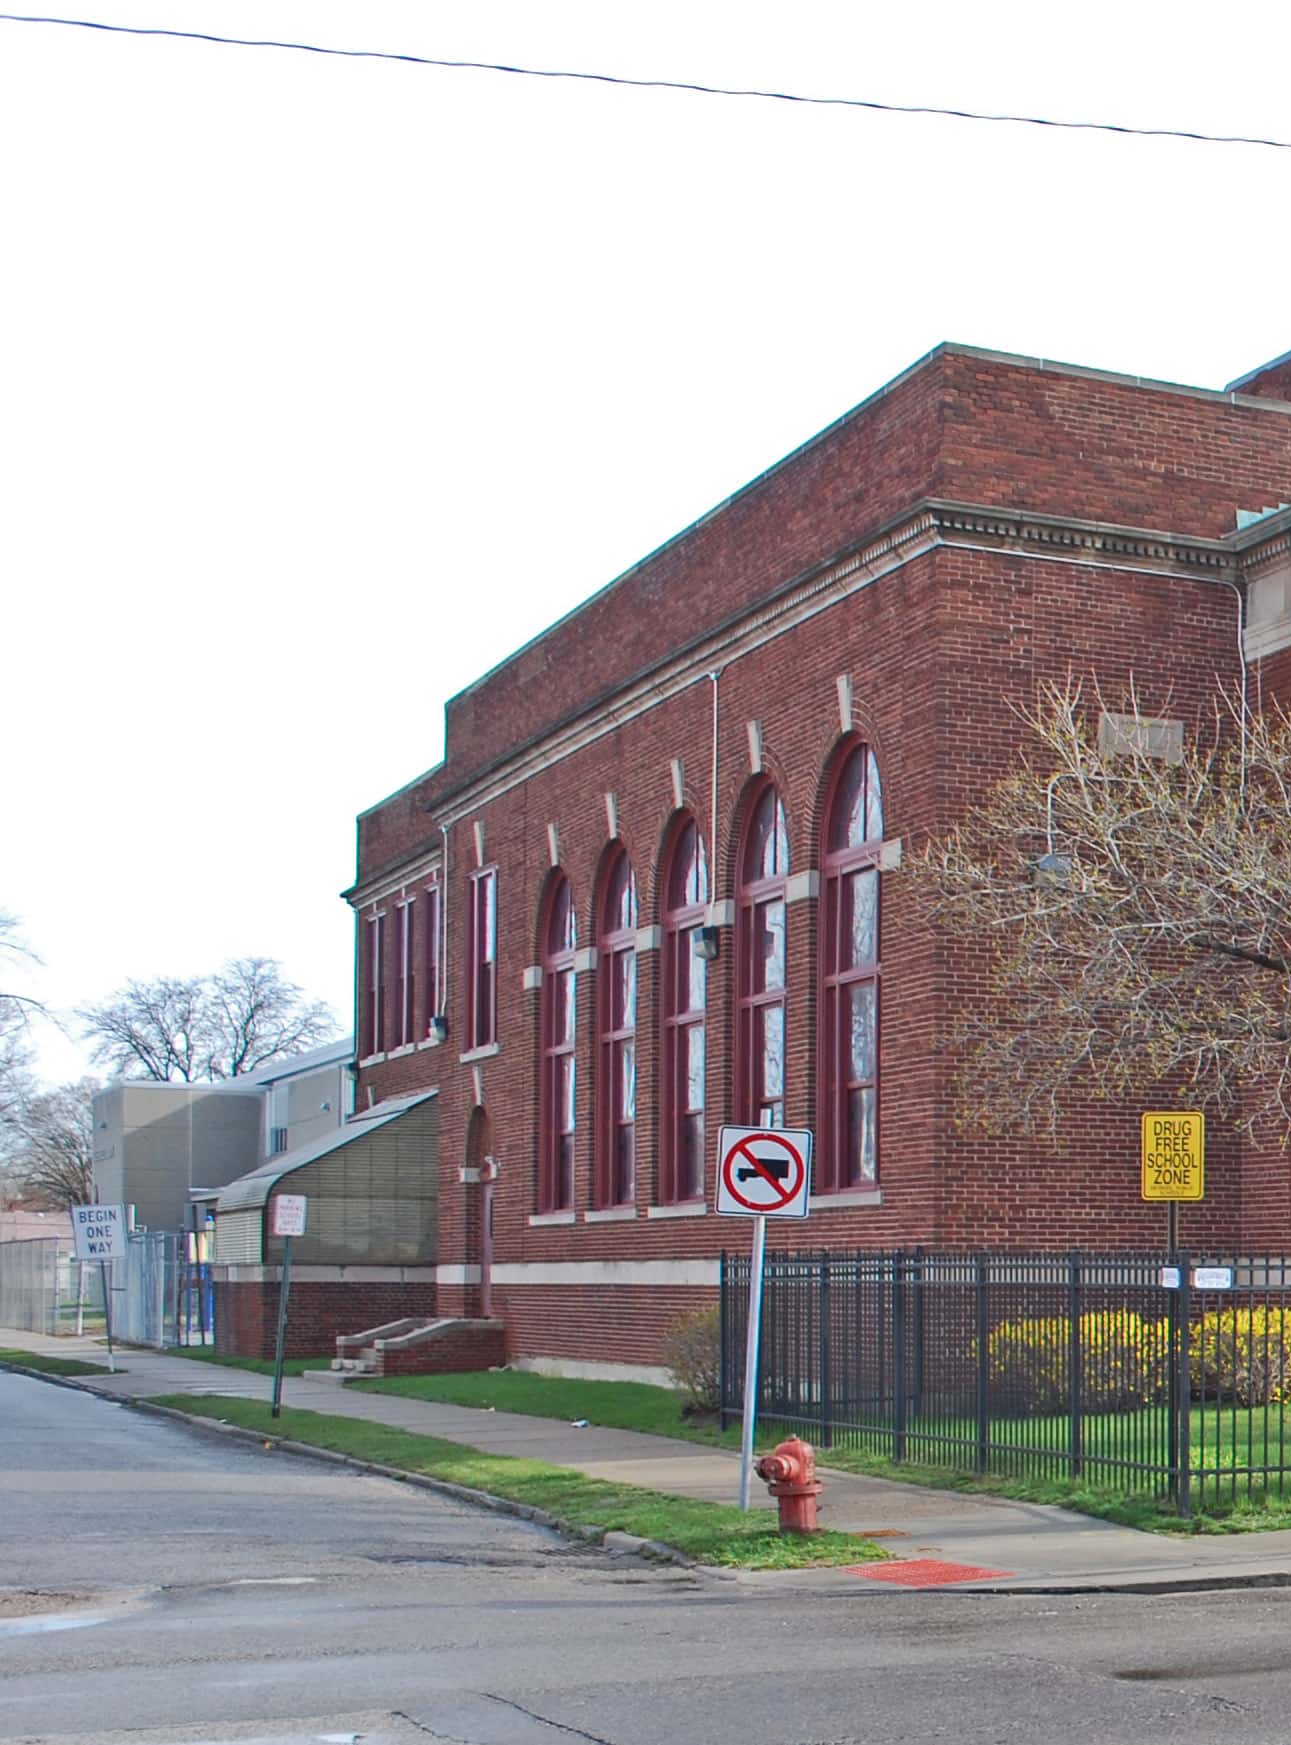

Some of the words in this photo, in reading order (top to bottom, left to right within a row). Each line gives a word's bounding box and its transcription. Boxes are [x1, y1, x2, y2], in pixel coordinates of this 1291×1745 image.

[1153, 1120, 1192, 1136] DRUG
[1155, 1136, 1190, 1152] FREE
[1147, 1152, 1198, 1168] SCHOOL
[1153, 1168, 1191, 1185] ZONE
[79, 1210, 117, 1223] BEGIN
[87, 1225, 112, 1239] ONE
[88, 1241, 112, 1253] WAY
